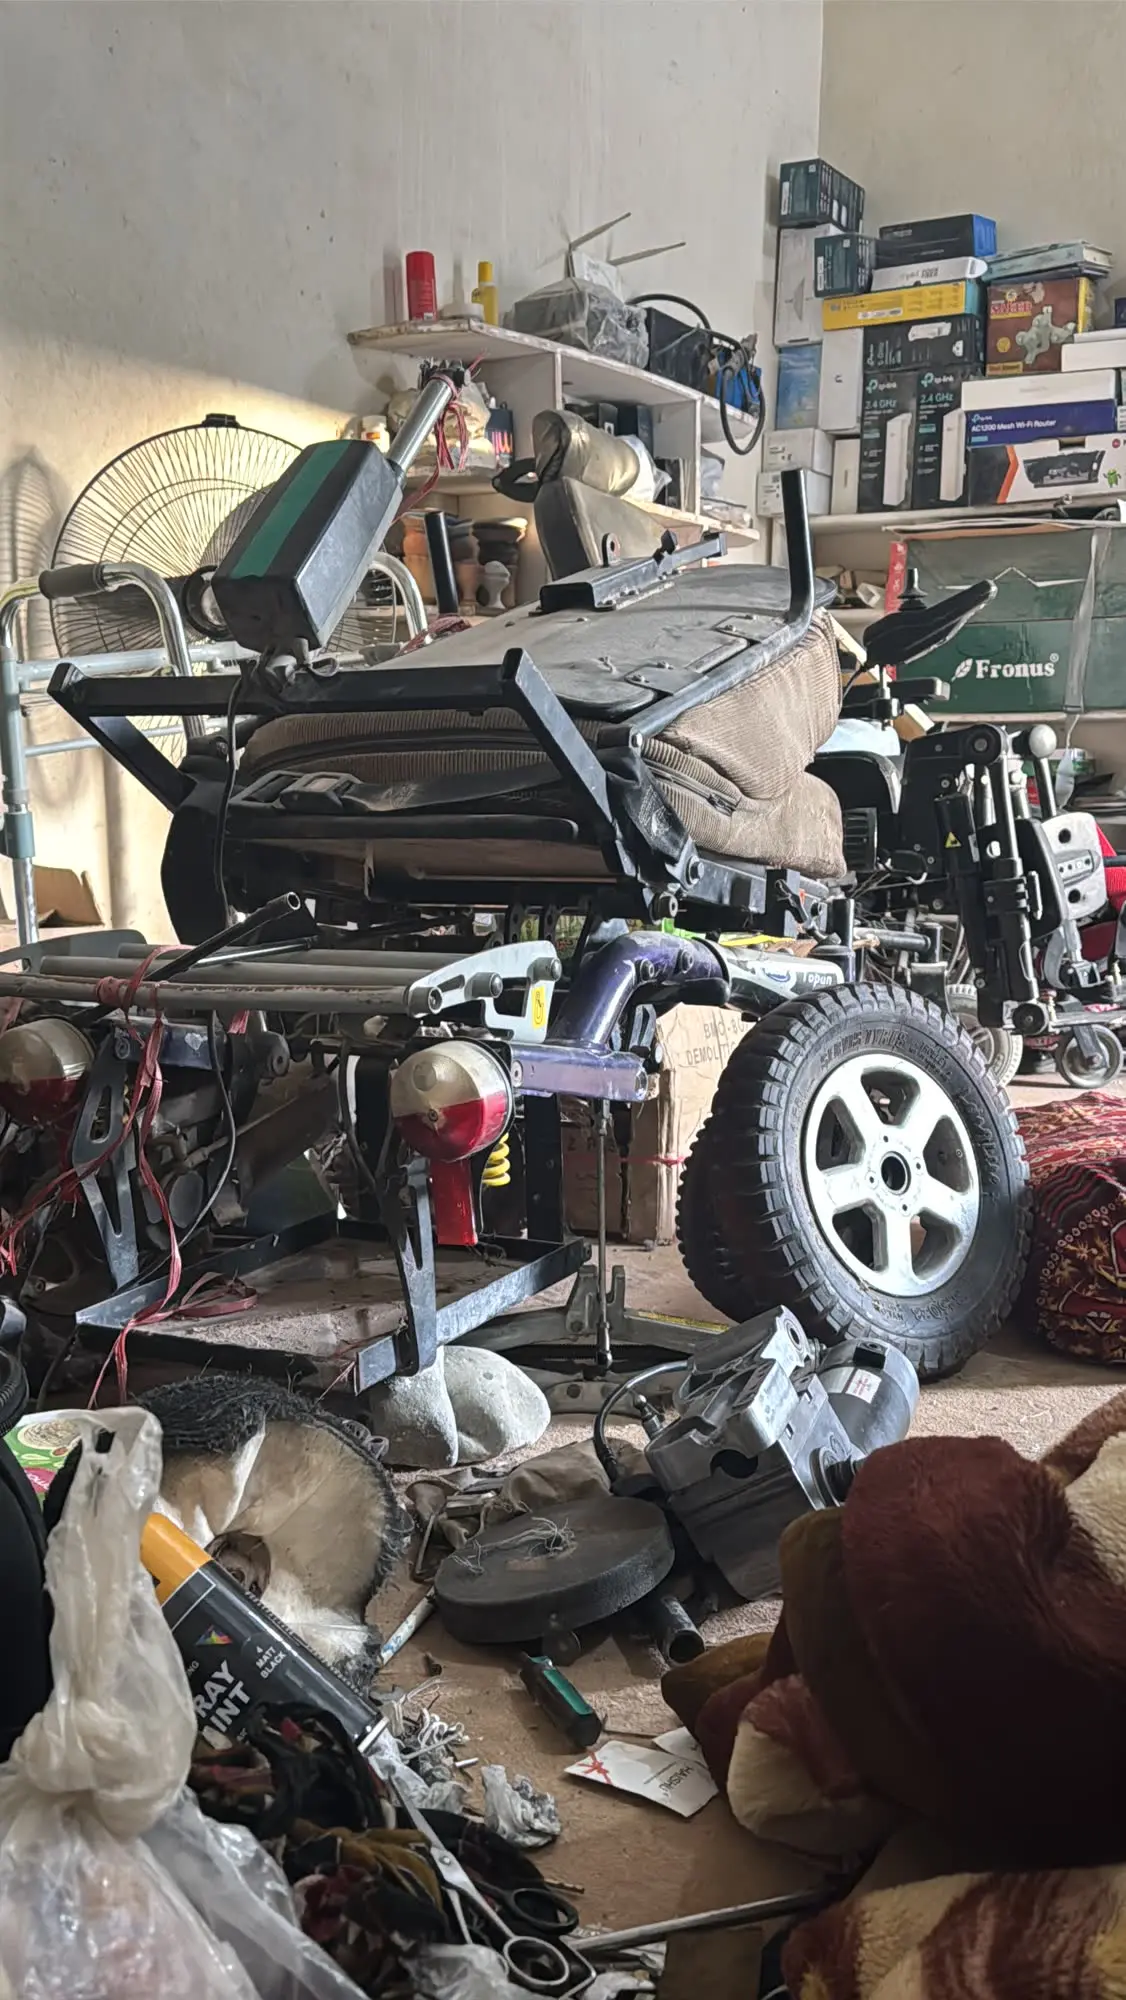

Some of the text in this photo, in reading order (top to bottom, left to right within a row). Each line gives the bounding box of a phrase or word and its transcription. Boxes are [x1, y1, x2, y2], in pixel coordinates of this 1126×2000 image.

[920, 392, 954, 403] 2.4 GHz
[997, 422, 1015, 431] Mesh
[1016, 420, 1034, 429] Wi-Fi
[1034, 419, 1057, 428] Router
[975, 659, 1056, 679] Fronus
[255, 1646, 276, 1669] MATT
[260, 1651, 287, 1679] BLACK
